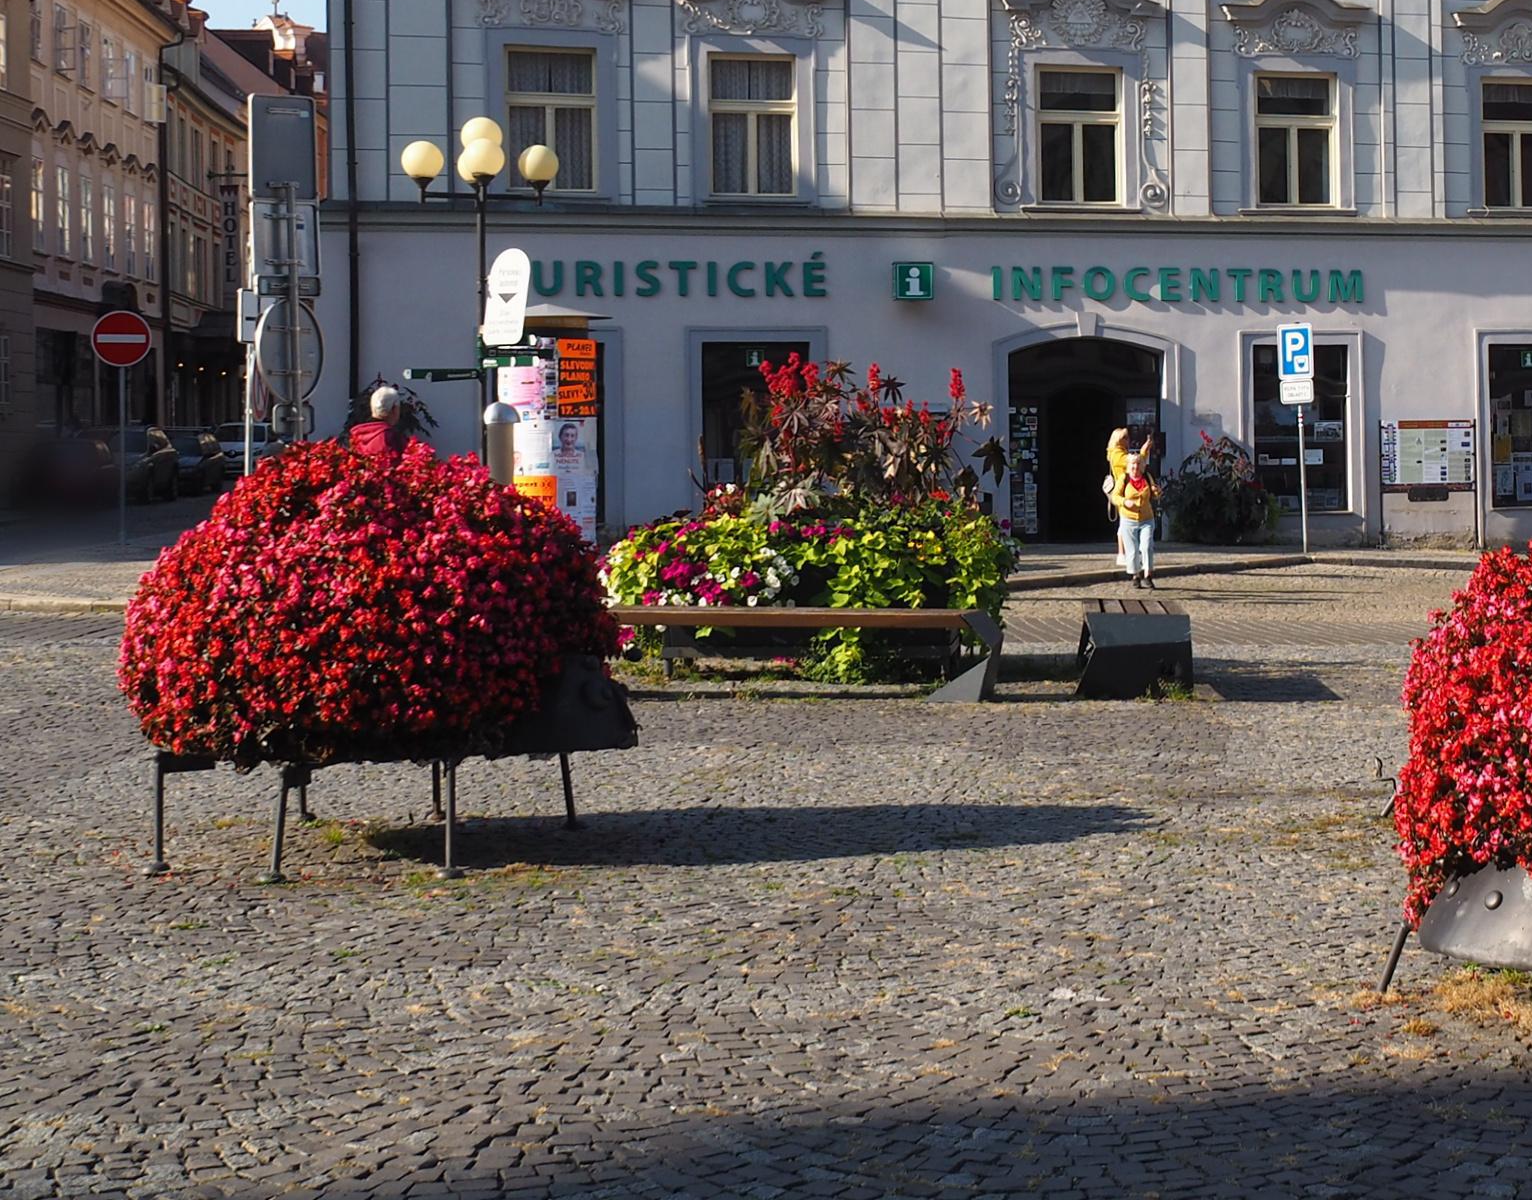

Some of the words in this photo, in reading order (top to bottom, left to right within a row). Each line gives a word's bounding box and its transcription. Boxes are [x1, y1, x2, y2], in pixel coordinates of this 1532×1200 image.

[223, 201, 237, 283] HOTEL
[532, 251, 828, 299] URISTICKÉ
[991, 265, 1365, 303] INFOCENTRUM
[1285, 331, 1305, 362] P
